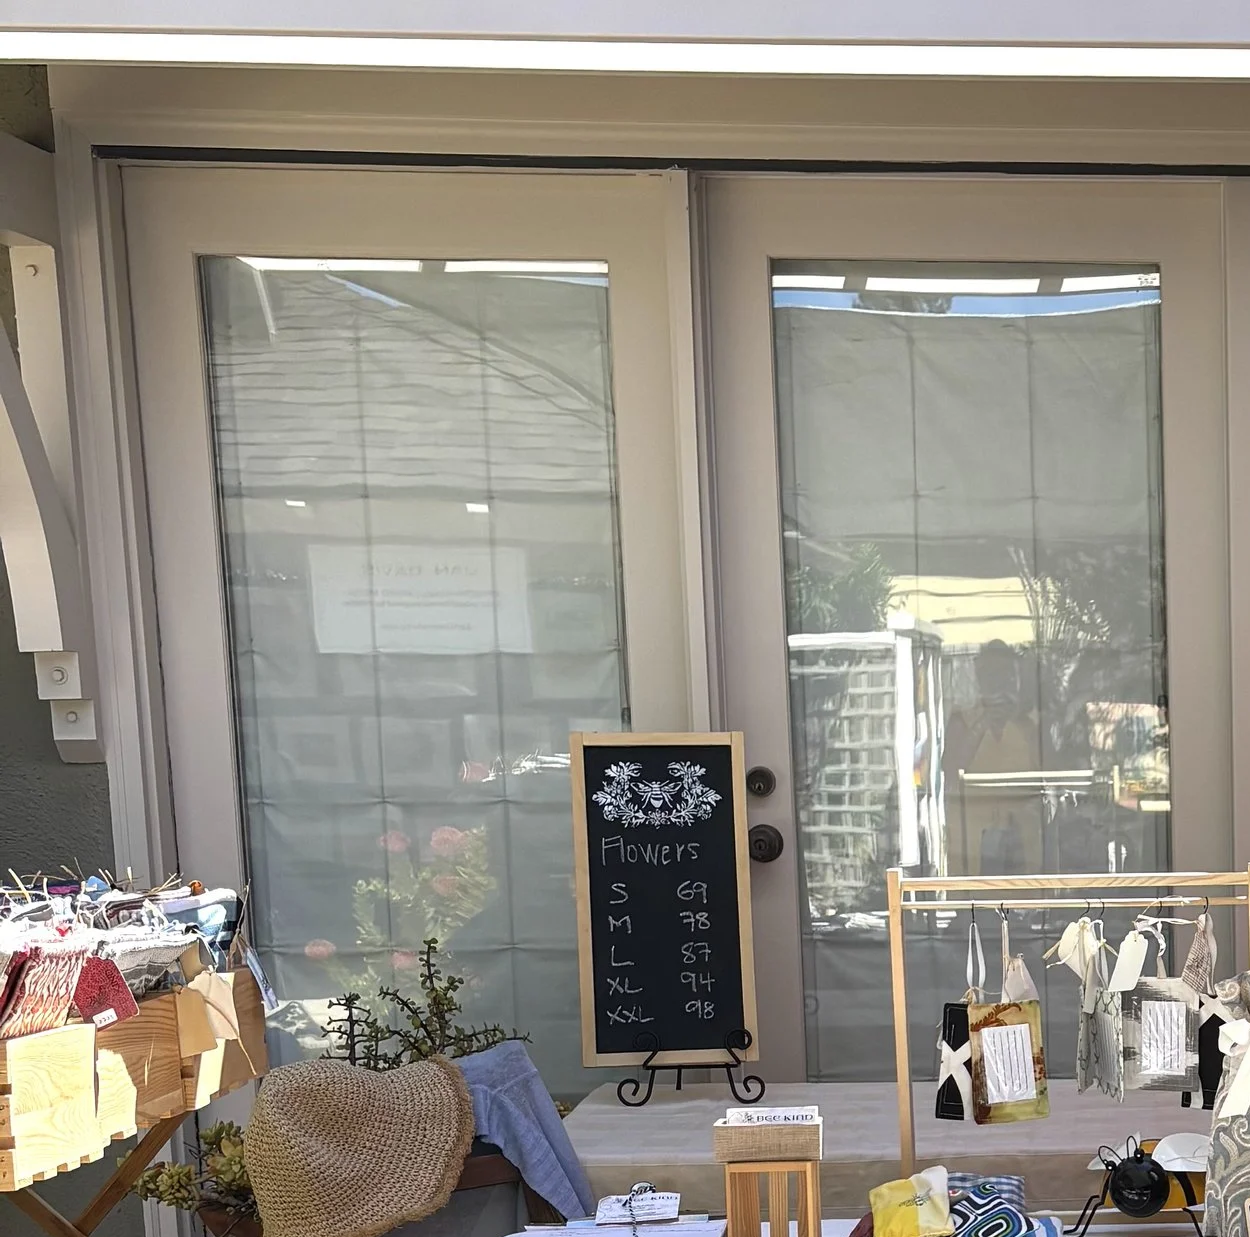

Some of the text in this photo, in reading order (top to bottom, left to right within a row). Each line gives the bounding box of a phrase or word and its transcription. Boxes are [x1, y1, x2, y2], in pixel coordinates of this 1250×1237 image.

[601, 835, 700, 866] Flowers
[609, 880, 708, 904] S 69
[607, 911, 711, 934] M 78
[611, 942, 712, 967] L 87
[606, 971, 715, 995] XL 94
[606, 999, 715, 1025] XXL 98
